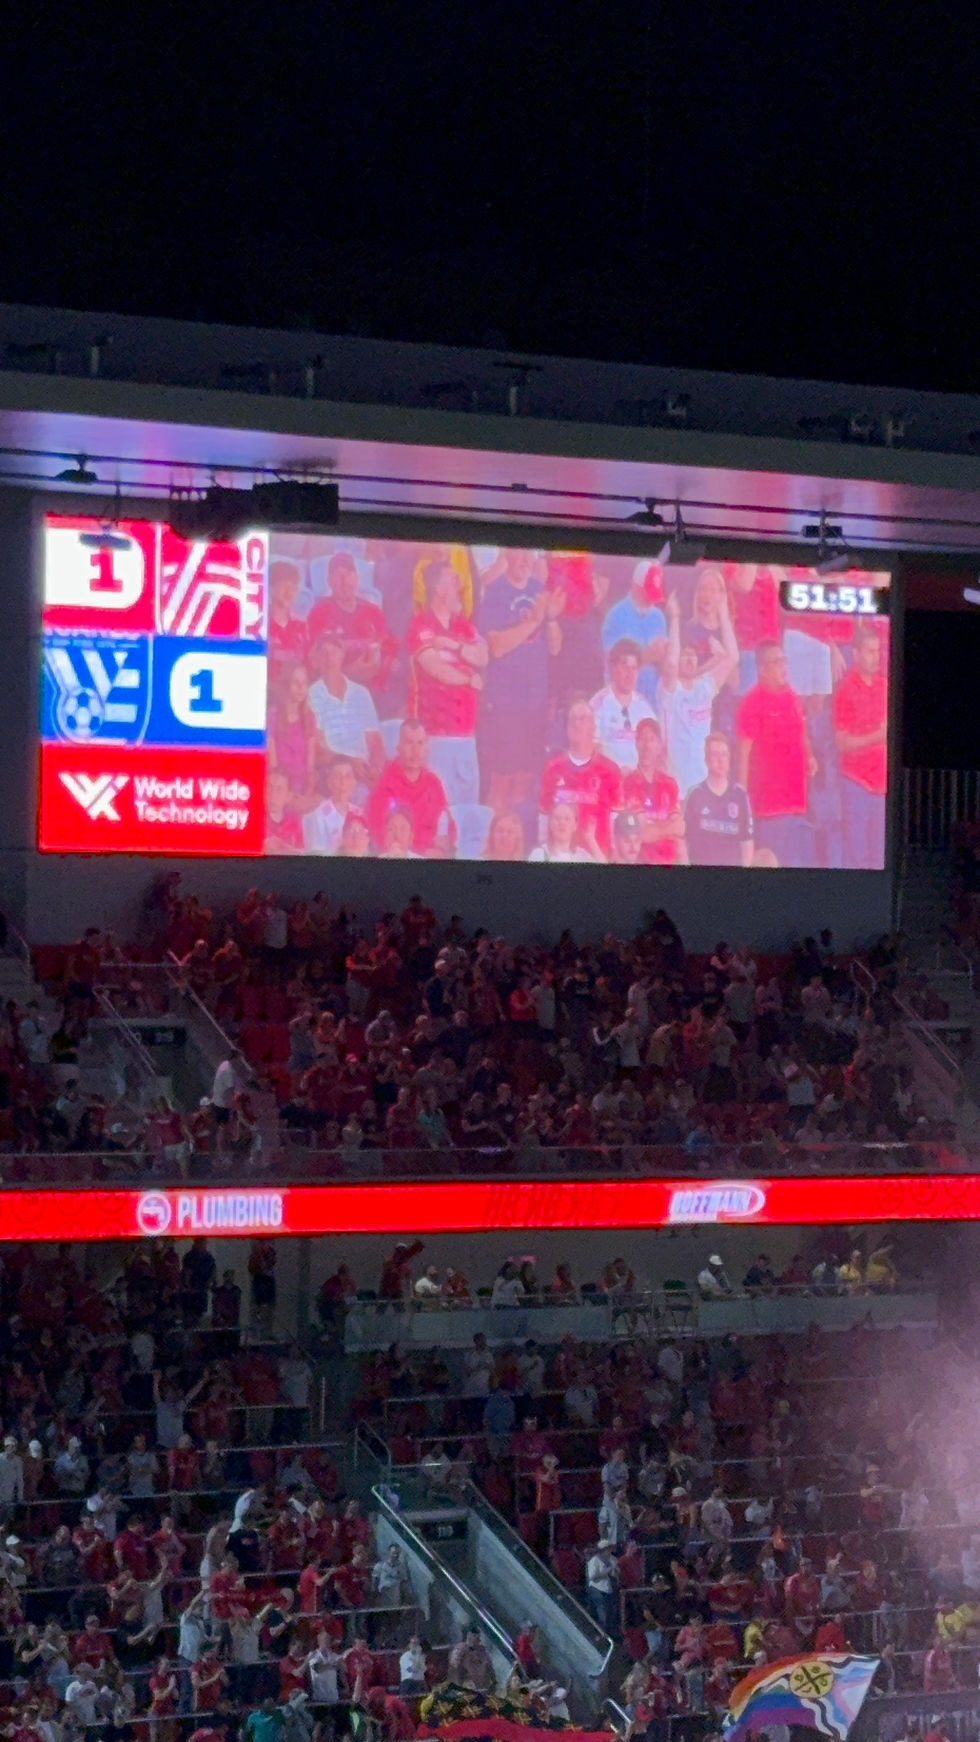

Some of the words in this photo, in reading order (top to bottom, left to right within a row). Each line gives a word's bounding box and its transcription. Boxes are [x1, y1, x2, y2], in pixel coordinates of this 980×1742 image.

[89, 545, 124, 593] 1
[787, 582, 878, 614] 51:51
[189, 668, 223, 713] 1
[134, 776, 194, 799] World
[199, 779, 250, 800] Wide
[134, 801, 249, 830] Technology
[177, 1194, 283, 1228] PLUMBING
